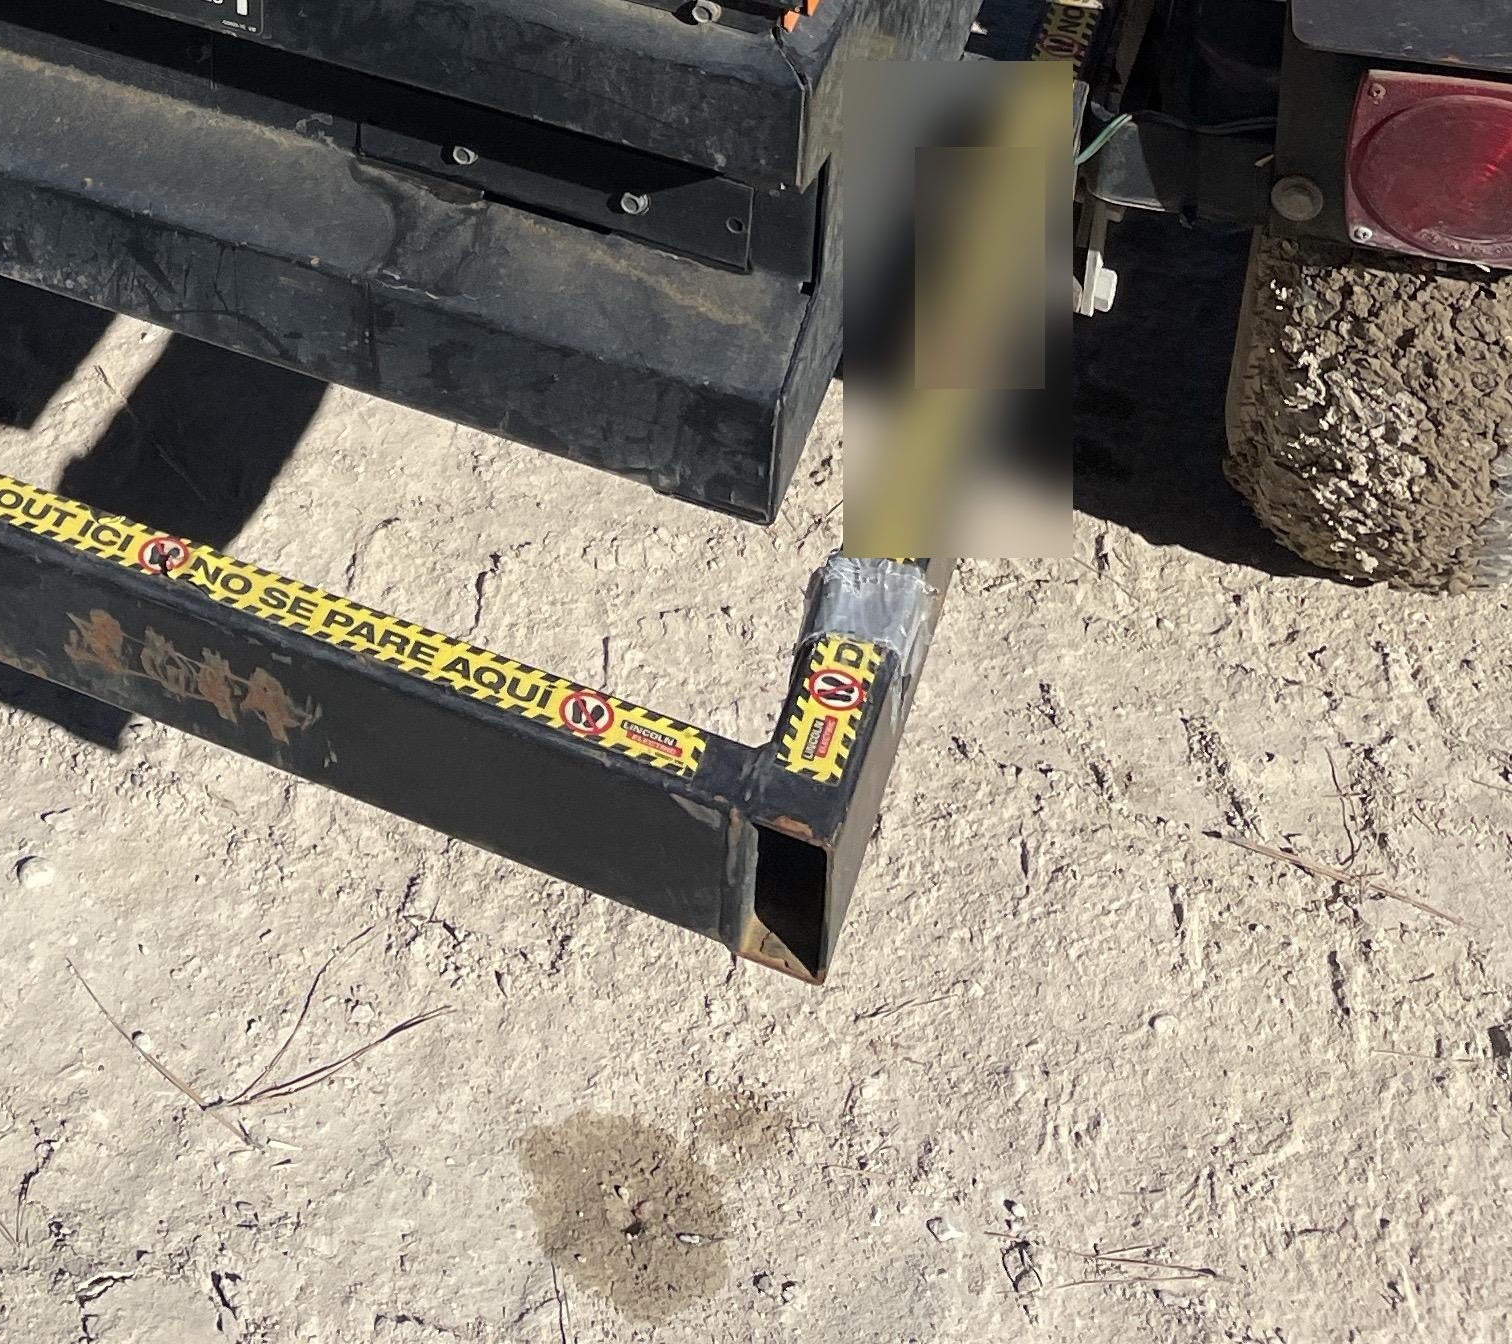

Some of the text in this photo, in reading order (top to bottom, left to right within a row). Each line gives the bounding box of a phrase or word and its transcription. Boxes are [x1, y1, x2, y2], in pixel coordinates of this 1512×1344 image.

[75, 519, 136, 554] ICI
[188, 555, 562, 711] NO SE PARE AQUÍ
[623, 721, 675, 746] LINCOLN
[805, 717, 826, 760] LINCOLN
